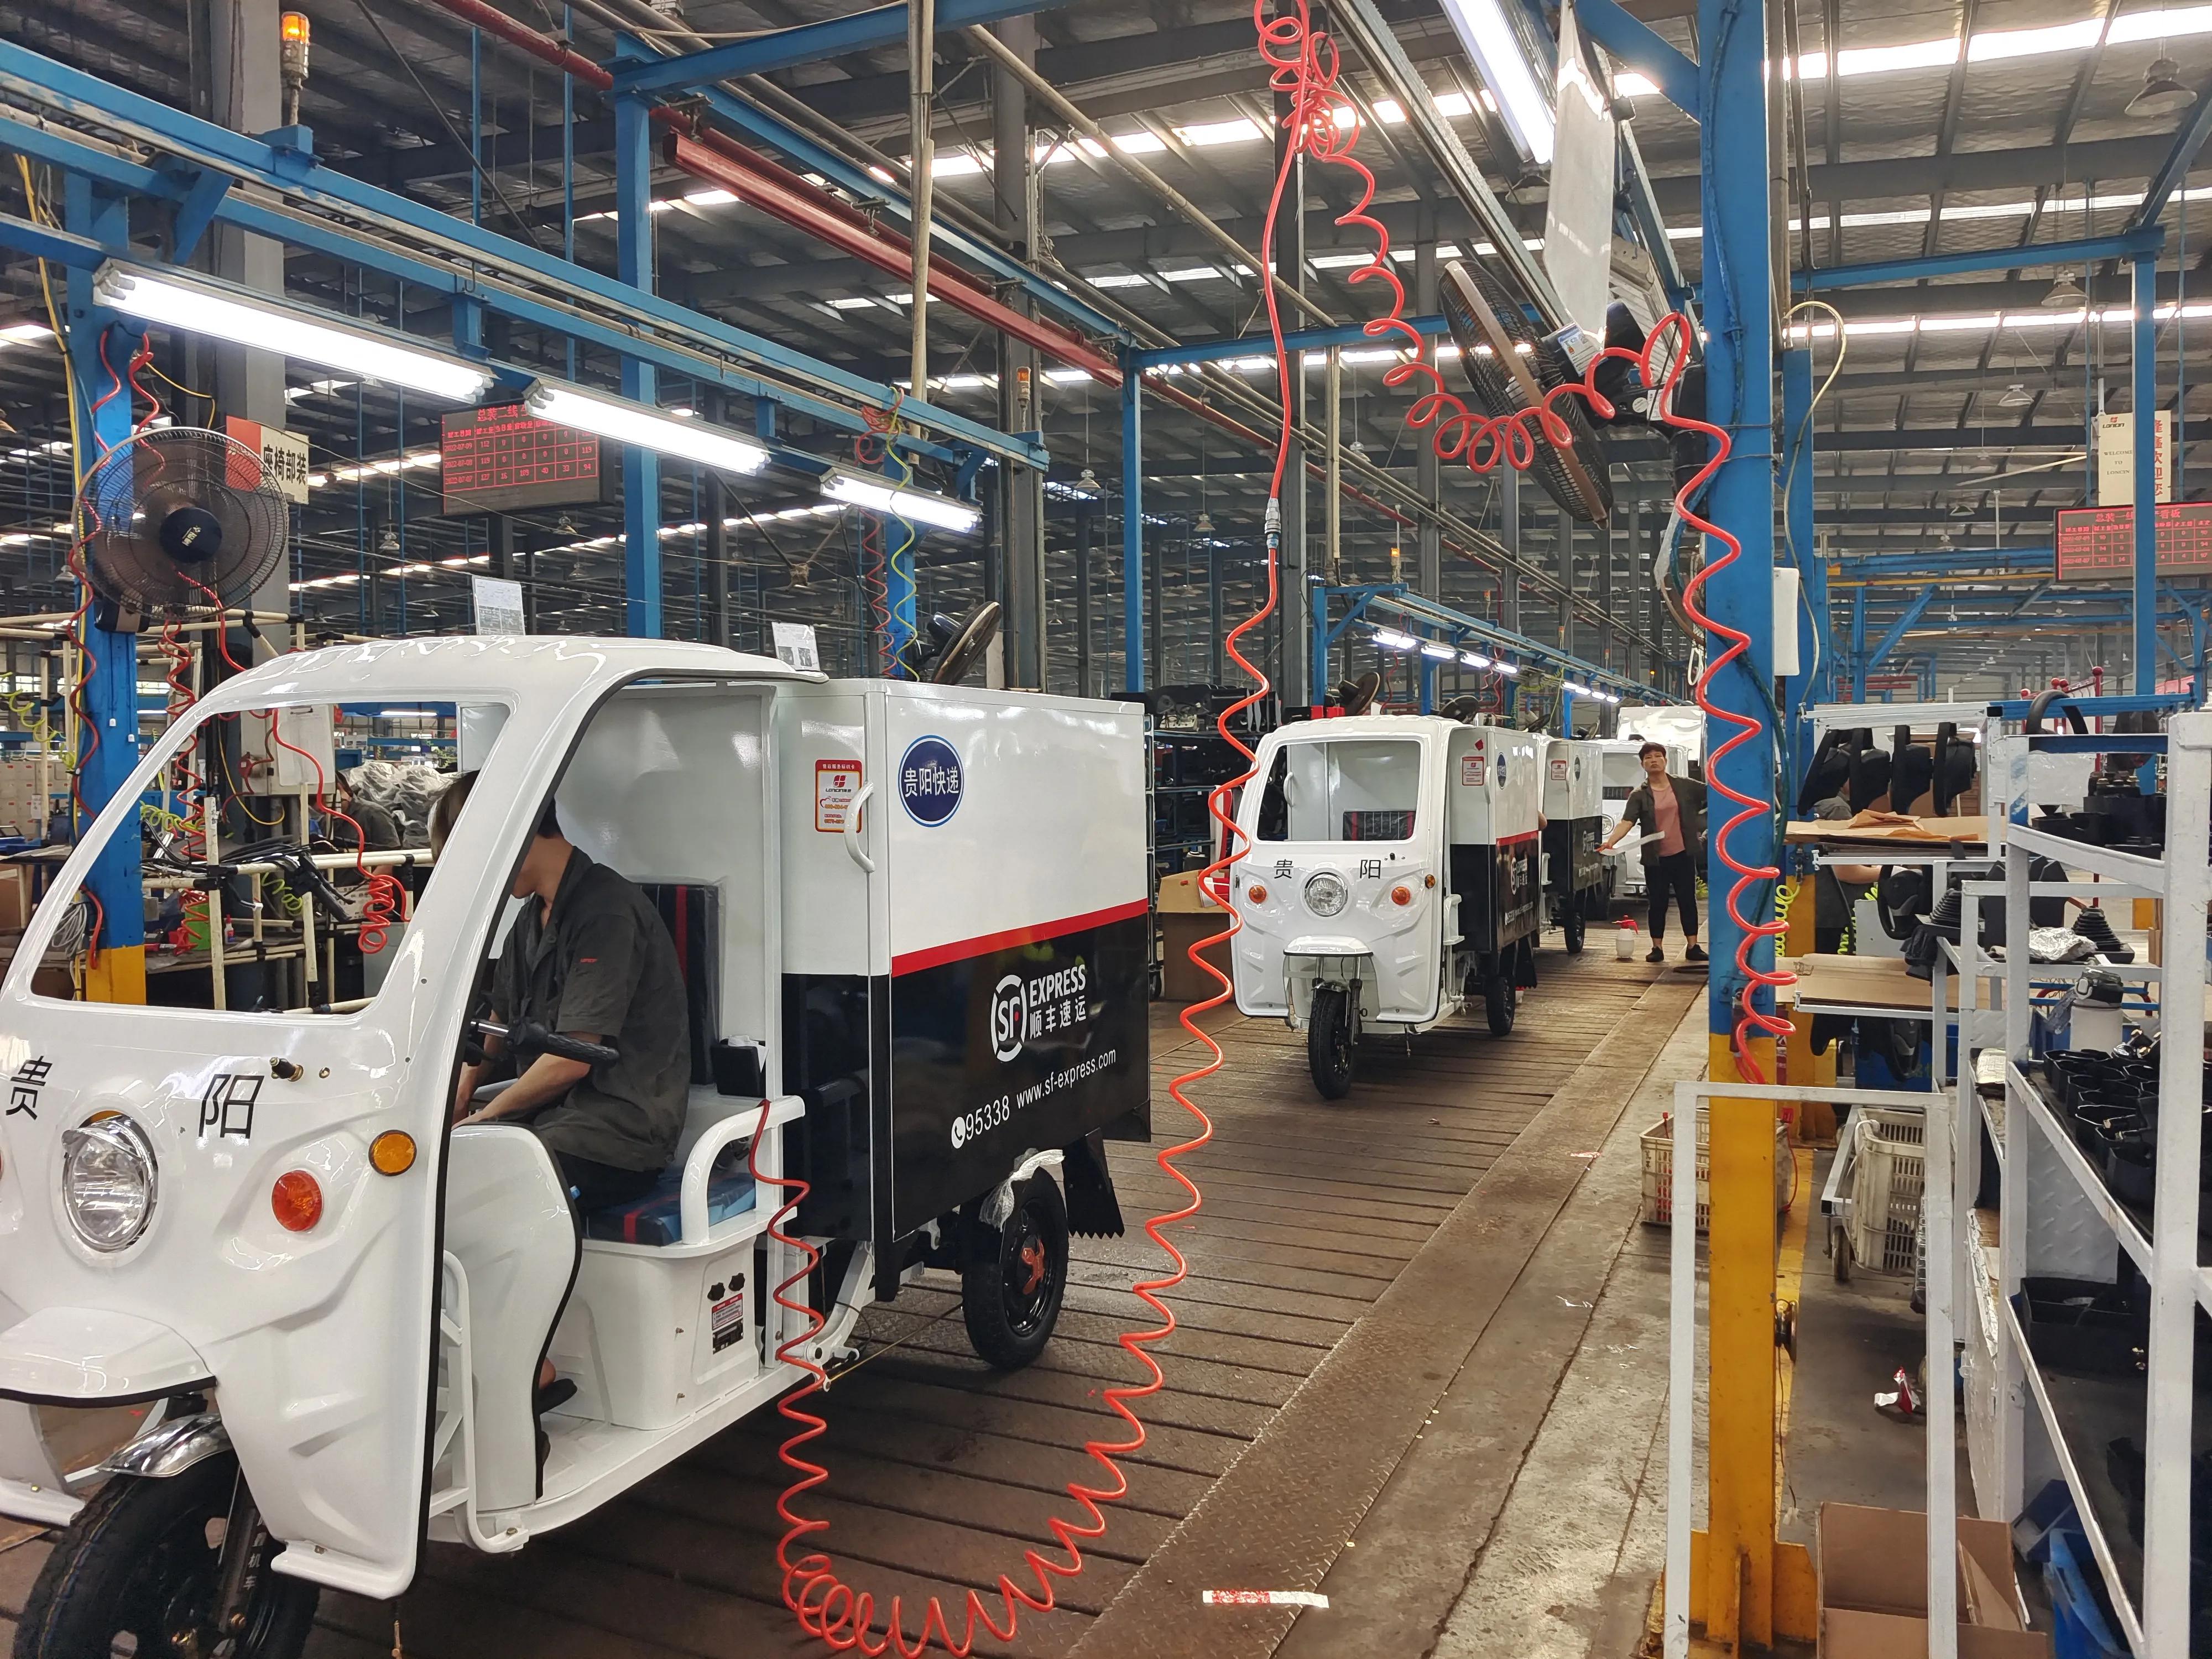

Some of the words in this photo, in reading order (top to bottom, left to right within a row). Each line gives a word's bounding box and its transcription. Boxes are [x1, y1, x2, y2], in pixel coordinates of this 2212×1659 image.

[263, 444, 306, 486] 座椅部装
[904, 768, 959, 798] 贵阳快递
[1273, 858, 1293, 879] 贵
[1359, 858, 1381, 880] 阳
[1030, 964, 1087, 1007] EXPRESS
[1030, 995, 1087, 1040] 顺丰速运
[6, 1055, 54, 1120] 贵
[197, 1073, 265, 1139] 阳
[966, 1095, 1010, 1141] 95338
[1016, 1047, 1117, 1109] www.sf-express.com
